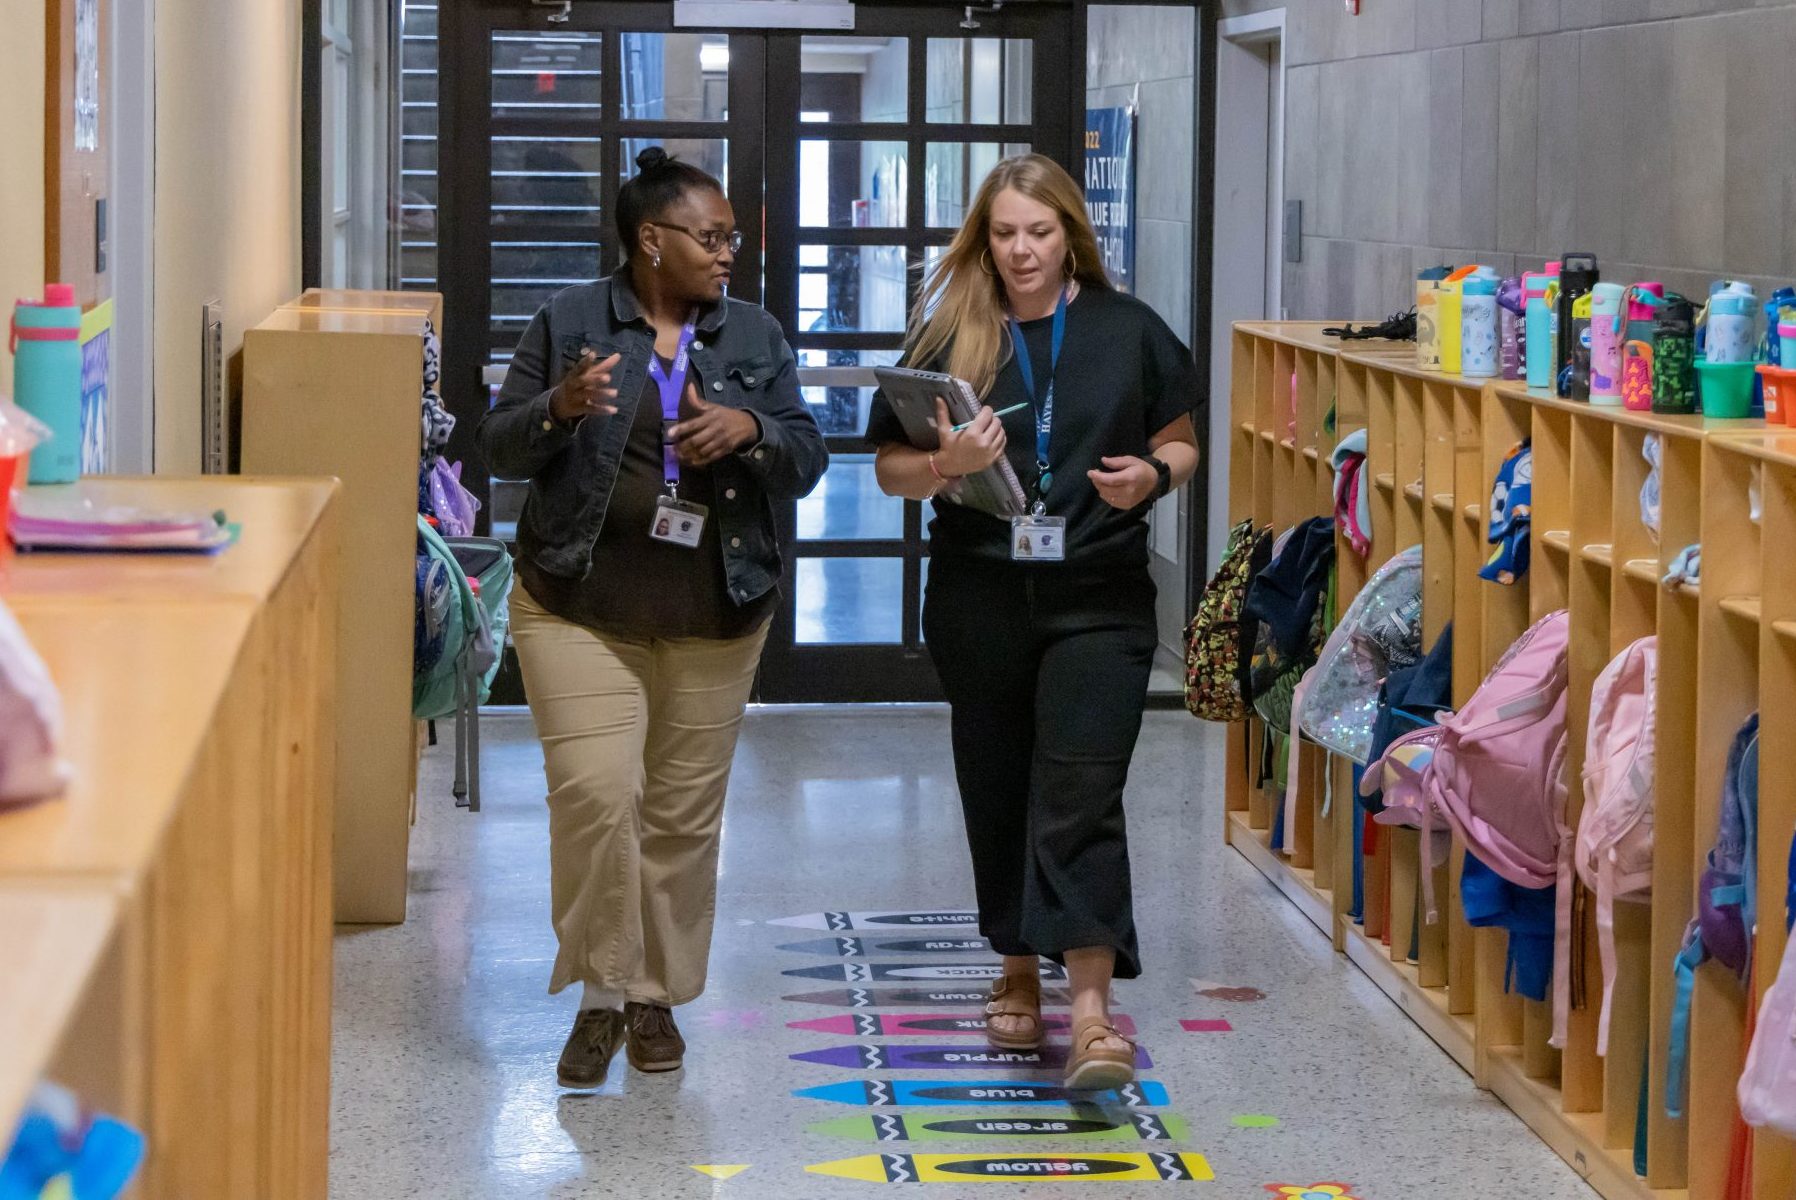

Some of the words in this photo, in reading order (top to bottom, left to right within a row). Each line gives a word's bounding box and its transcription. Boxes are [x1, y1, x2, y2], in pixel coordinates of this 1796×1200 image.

[924, 941, 984, 950] gray
[928, 993, 988, 1001] own
[955, 1019, 988, 1029] nk
[943, 1053, 1041, 1063] purple
[968, 1088, 1036, 1099] blue
[975, 1121, 1070, 1132] green
[985, 1161, 1090, 1173] yellow
